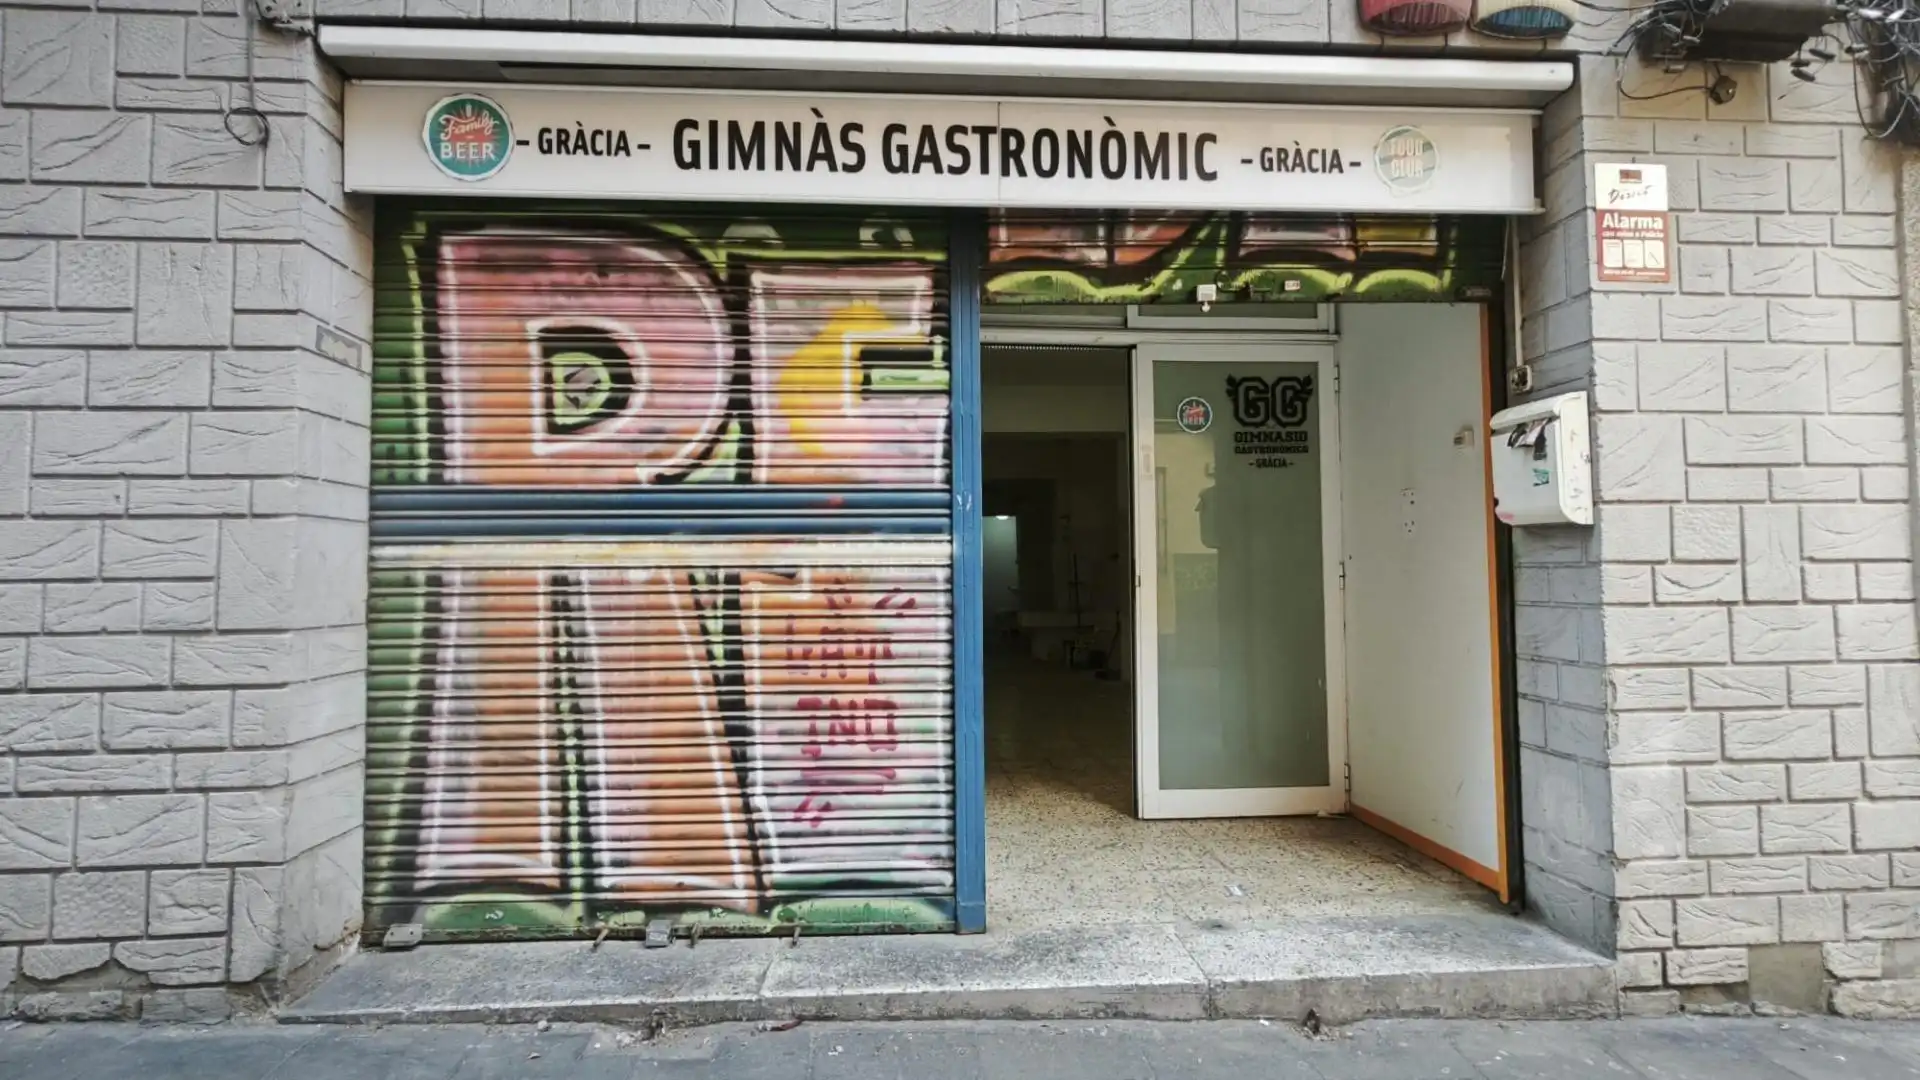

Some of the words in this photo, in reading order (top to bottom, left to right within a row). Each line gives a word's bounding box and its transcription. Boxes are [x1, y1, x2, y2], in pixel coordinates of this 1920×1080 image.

[439, 110, 499, 140] Family
[440, 142, 499, 160] BEER
[673, 107, 866, 173] GIMNÀS
[882, 115, 1218, 181] GASTRONÒMIC
[1602, 211, 1664, 230] Alarma
